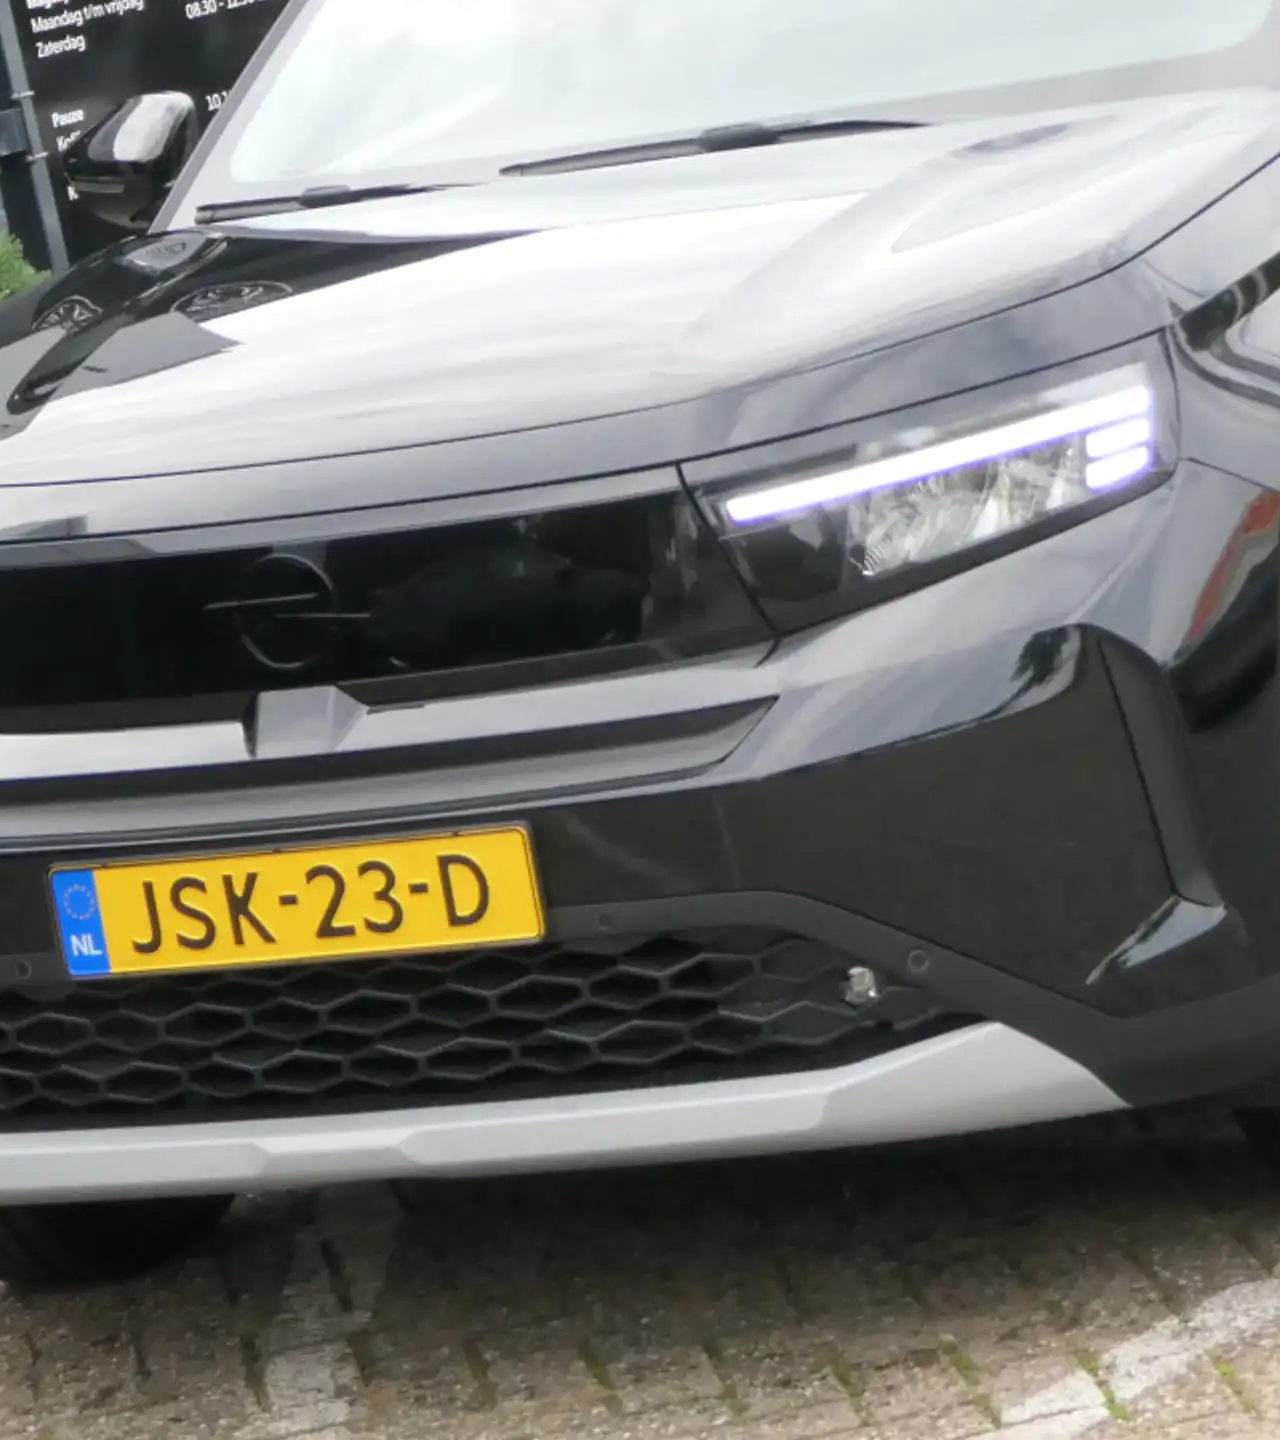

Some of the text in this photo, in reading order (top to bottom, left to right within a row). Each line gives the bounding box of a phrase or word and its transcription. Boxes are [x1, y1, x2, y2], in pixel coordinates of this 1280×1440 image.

[30, 10, 84, 33] Maandag
[51, 109, 85, 128] Pauze
[132, 853, 489, 954] JSK-23-D
[71, 933, 103, 957] NL
